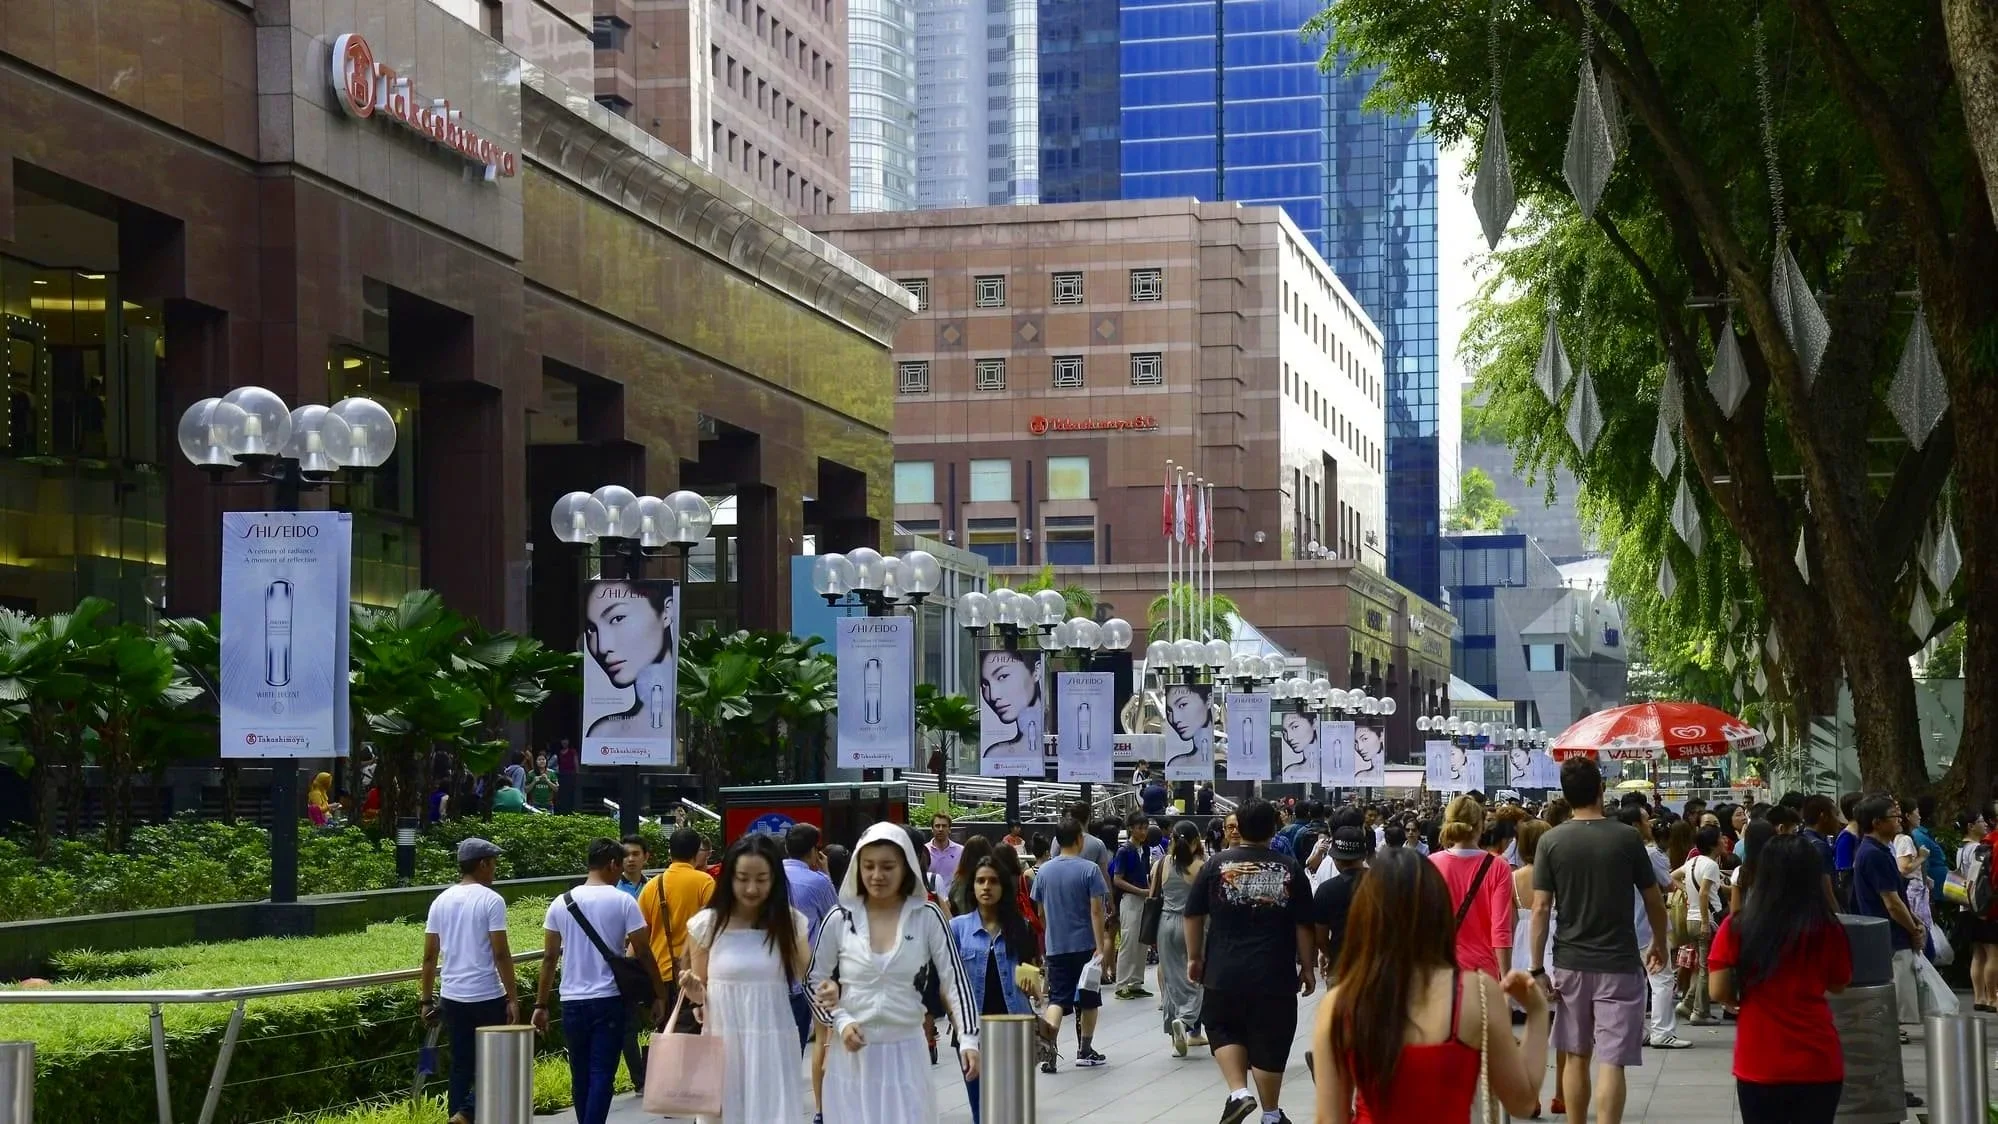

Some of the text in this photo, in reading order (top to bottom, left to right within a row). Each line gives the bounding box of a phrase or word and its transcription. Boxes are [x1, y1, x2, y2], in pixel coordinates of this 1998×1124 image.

[374, 62, 515, 182] Takashimaya
[1051, 416, 1134, 432] Takashimaya
[240, 524, 319, 539] SHISEIDO
[254, 548, 277, 556] century
[847, 623, 898, 634] SHISEIDO
[1066, 678, 1103, 686] SHISEIDO
[257, 735, 305, 745] Takashimaya
[1608, 748, 1653, 760] WALL'S
[1679, 743, 1714, 756] SHARE
